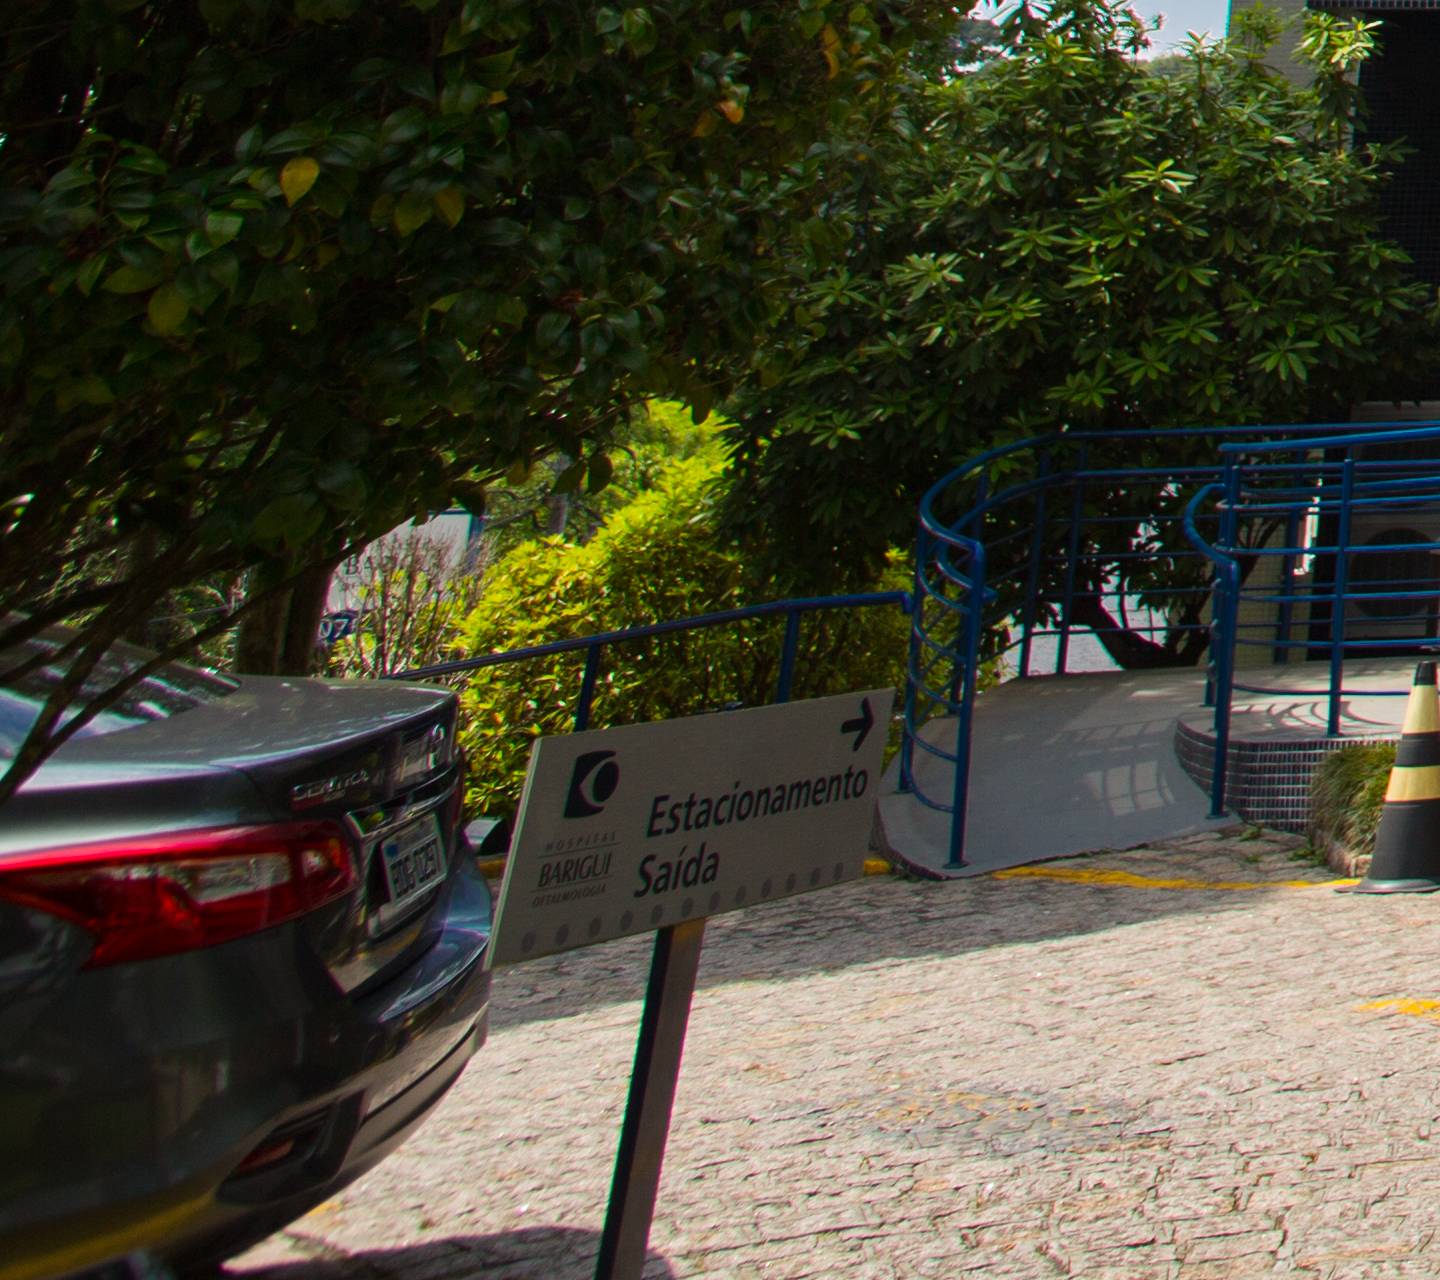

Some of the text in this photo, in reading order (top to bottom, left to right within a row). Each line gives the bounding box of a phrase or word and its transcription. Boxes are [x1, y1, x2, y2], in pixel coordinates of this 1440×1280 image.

[646, 763, 868, 838] Estacionamento
[537, 851, 612, 888] BARIGUI
[633, 843, 720, 899] Saída
